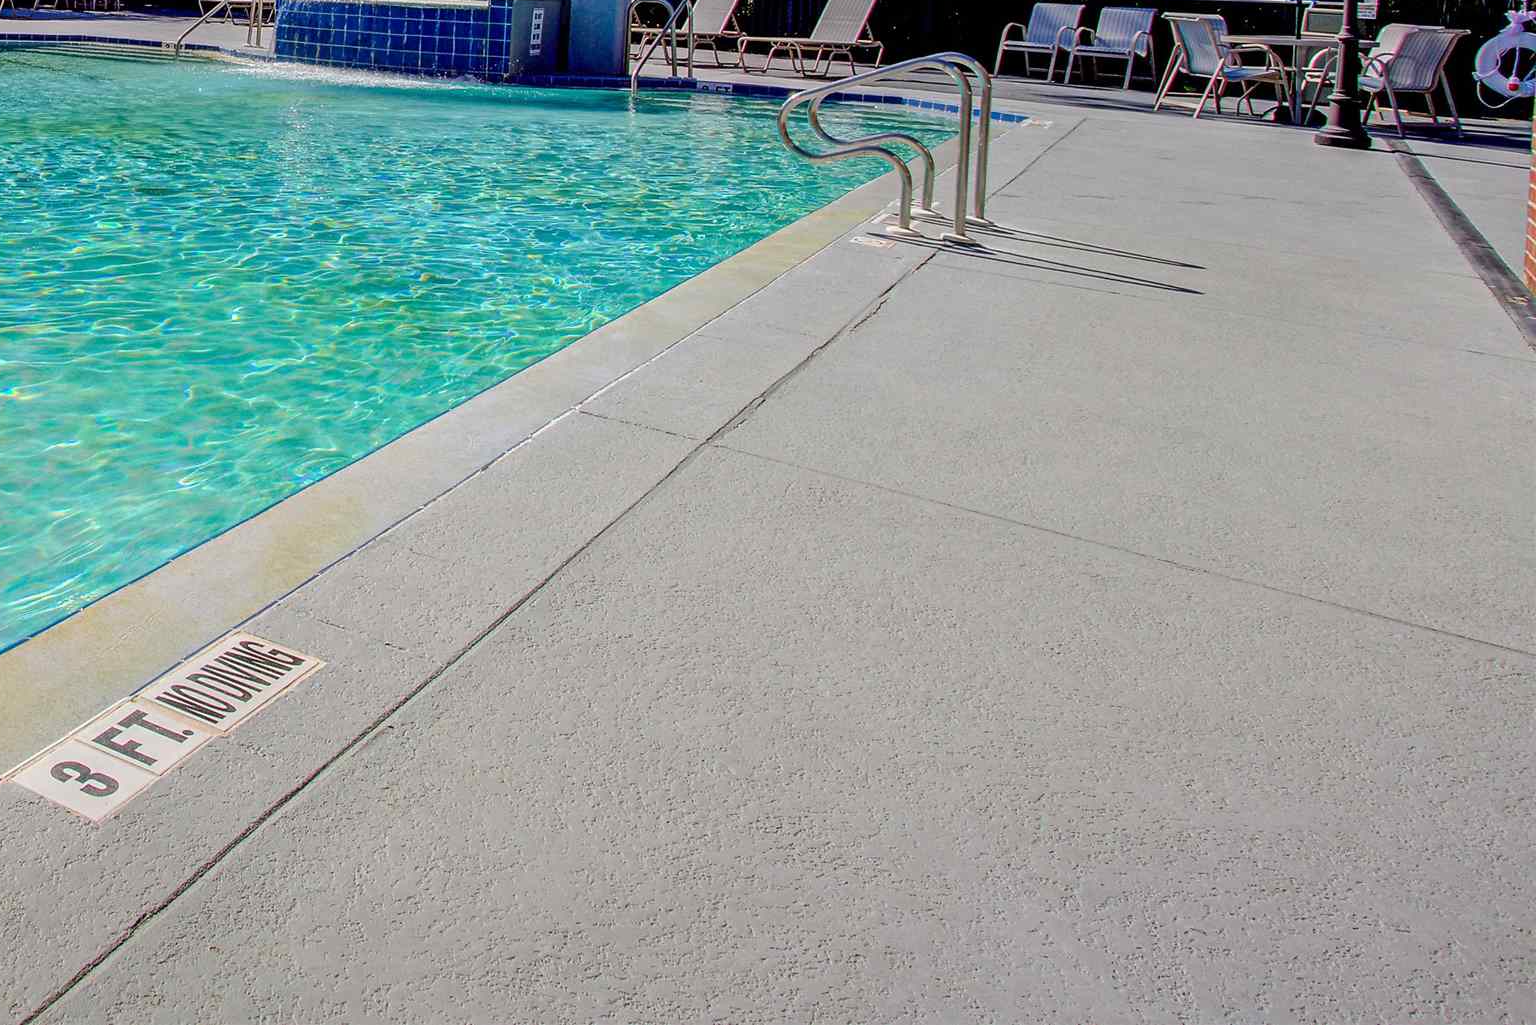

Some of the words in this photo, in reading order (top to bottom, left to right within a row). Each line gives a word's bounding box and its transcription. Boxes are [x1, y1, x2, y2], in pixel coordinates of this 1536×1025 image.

[186, 640, 306, 703] DIVING
[155, 684, 237, 725] NO
[92, 708, 195, 766] FT.
[50, 761, 120, 798] 3
